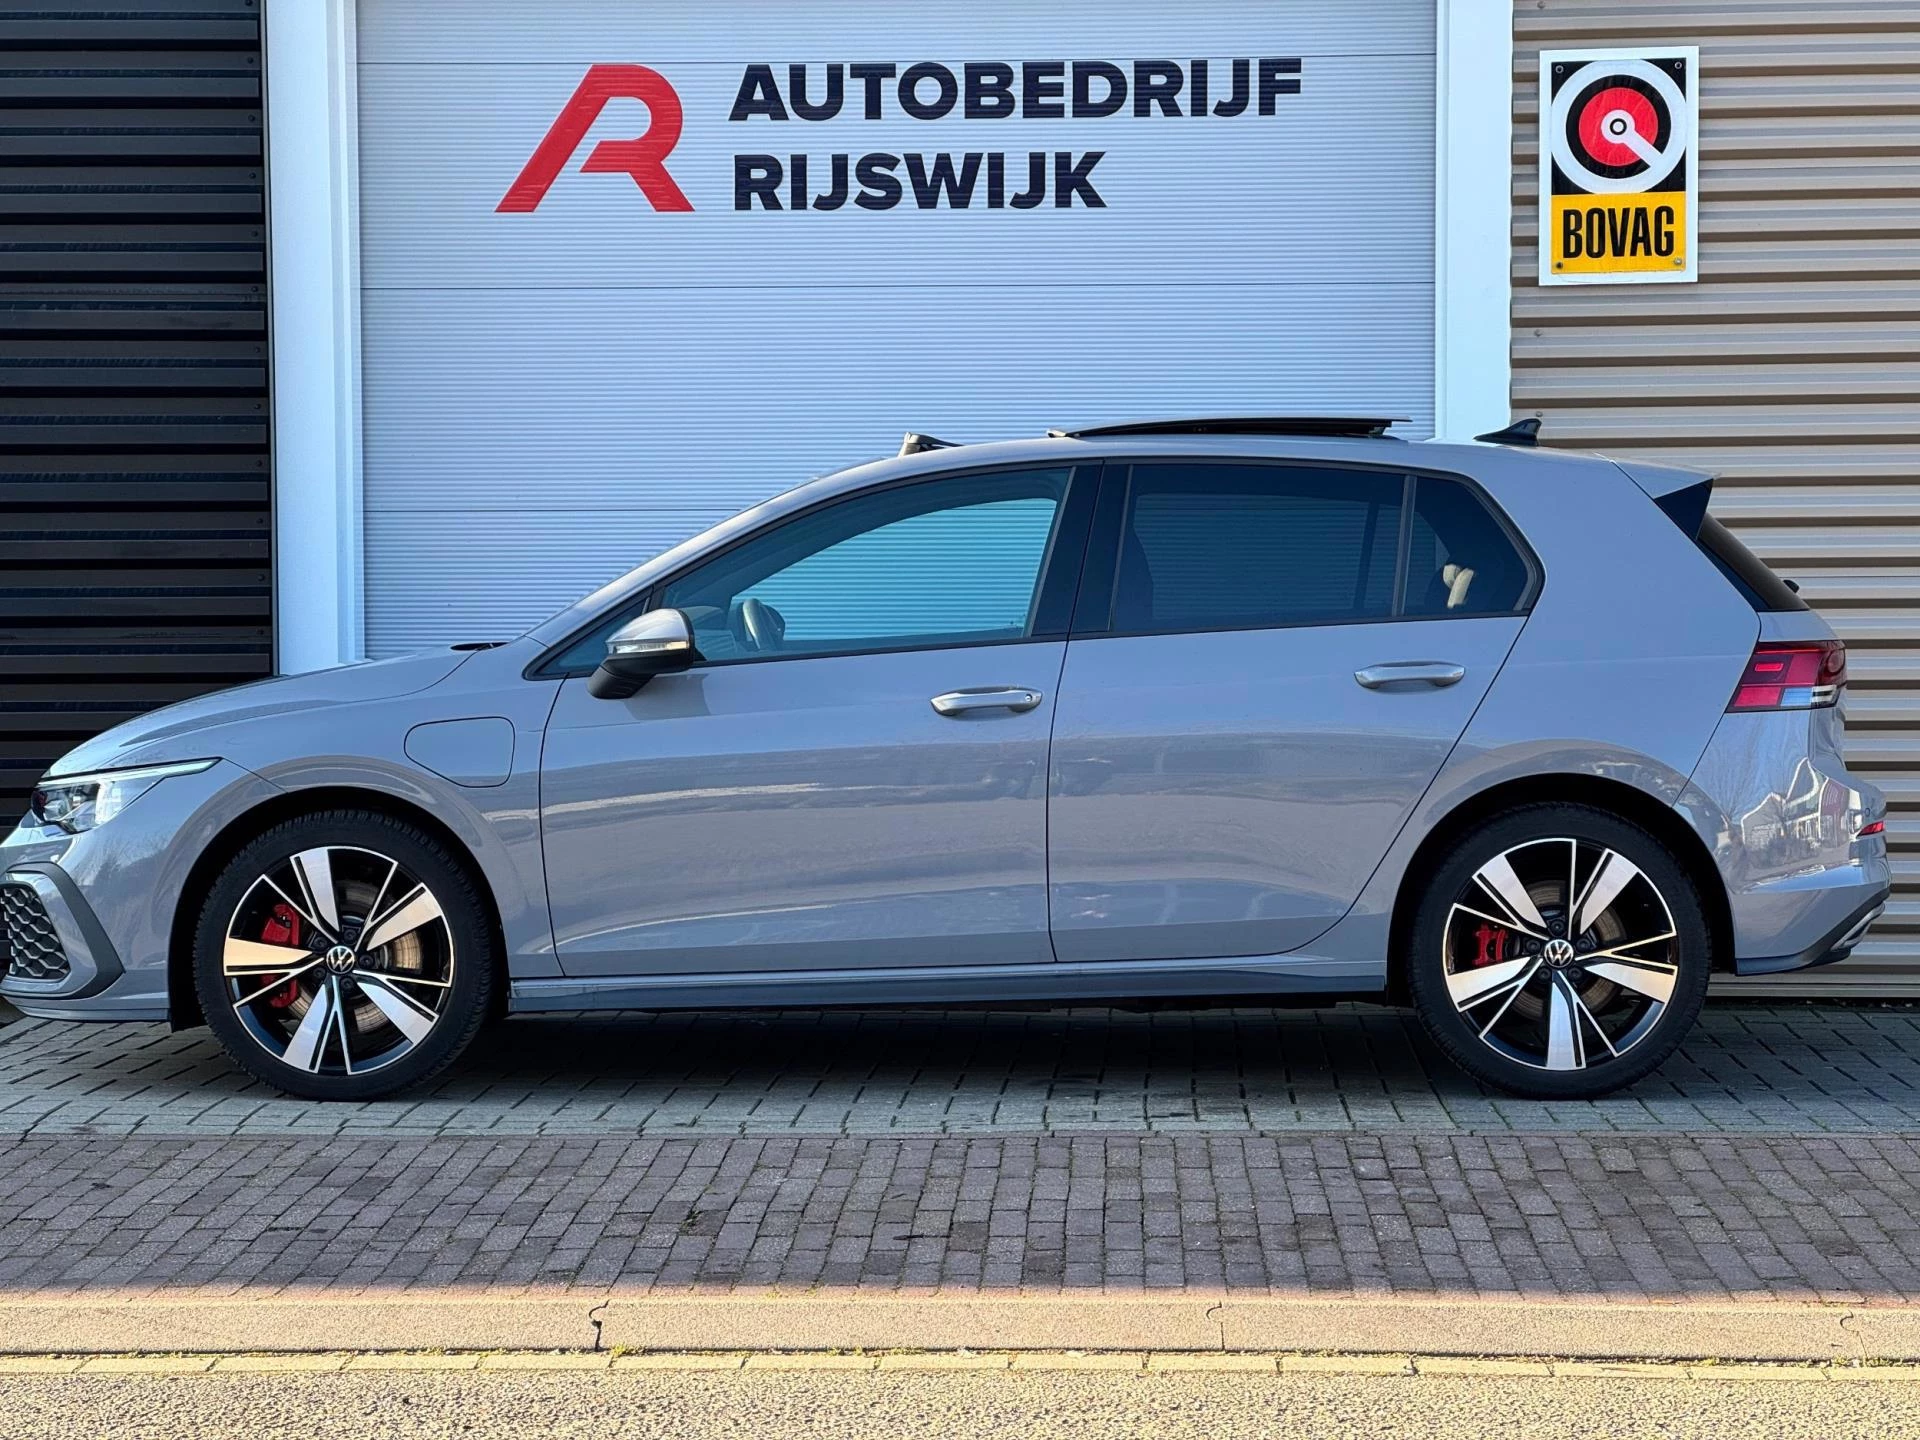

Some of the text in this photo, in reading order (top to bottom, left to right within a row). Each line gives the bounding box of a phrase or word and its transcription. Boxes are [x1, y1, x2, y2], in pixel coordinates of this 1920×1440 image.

[728, 58, 1302, 122] AUTOBEDRIJF
[734, 152, 1107, 212] RIJSWIJK
[1562, 206, 1675, 259] BOVAG
